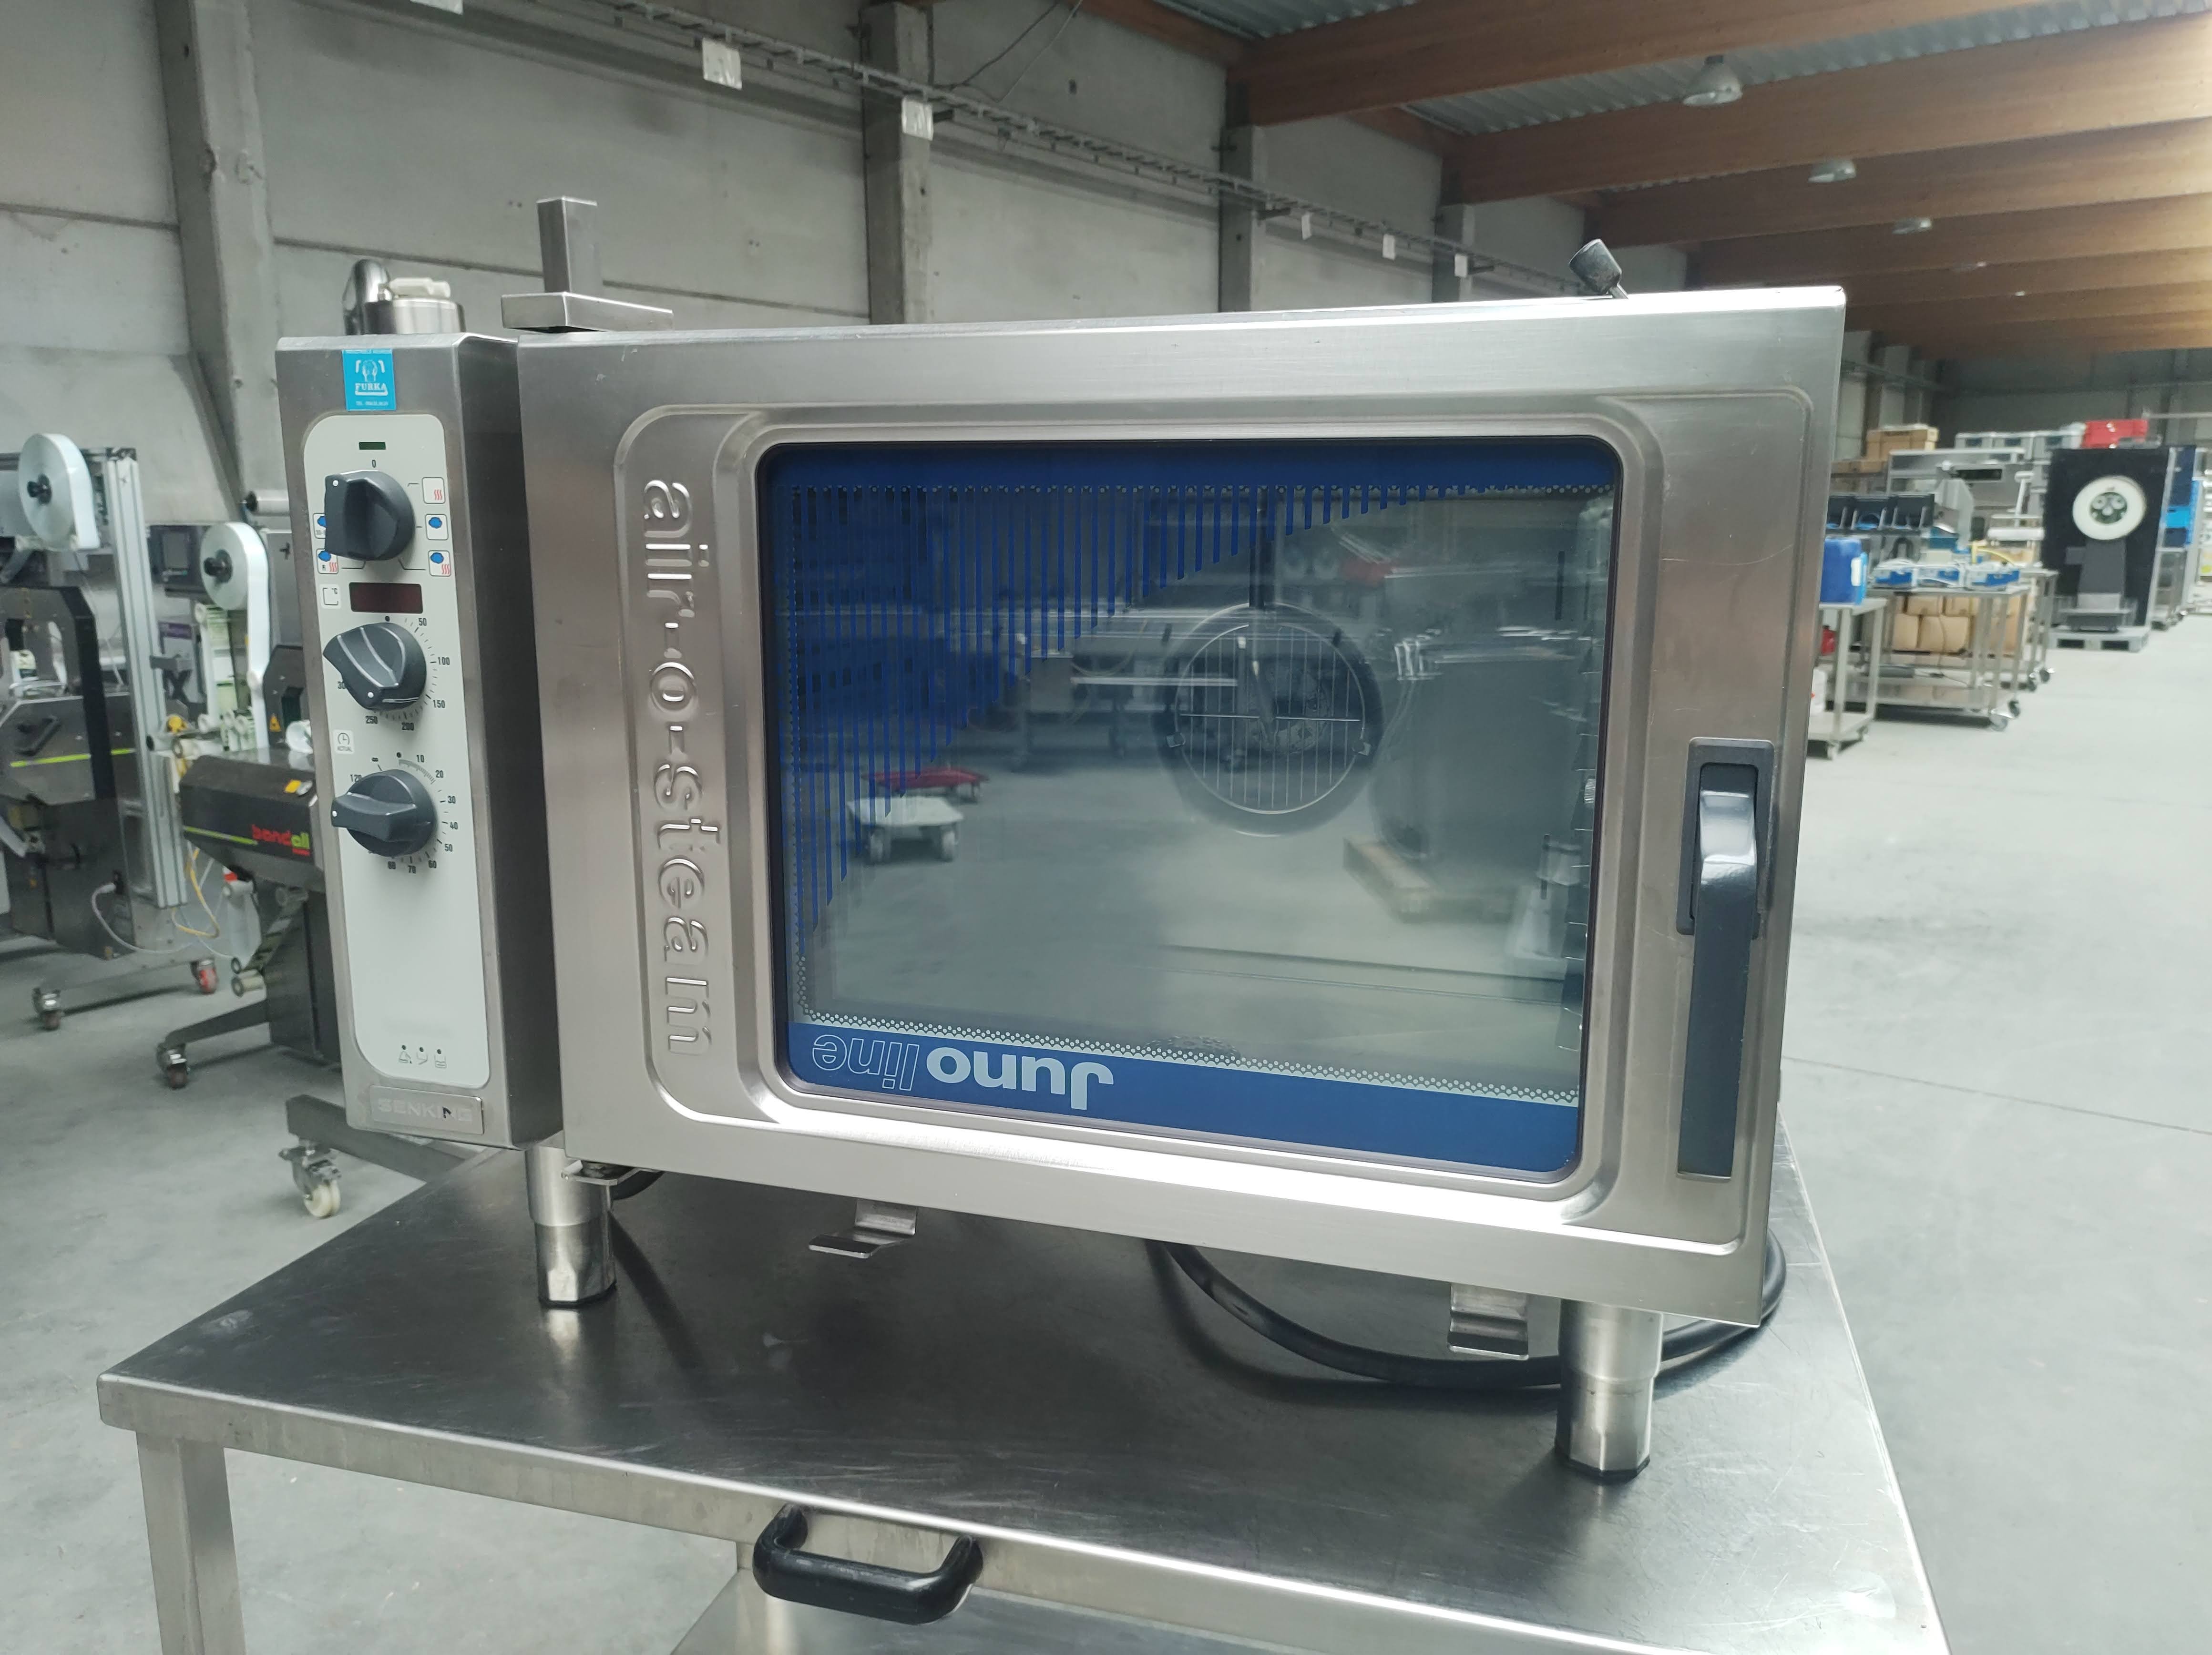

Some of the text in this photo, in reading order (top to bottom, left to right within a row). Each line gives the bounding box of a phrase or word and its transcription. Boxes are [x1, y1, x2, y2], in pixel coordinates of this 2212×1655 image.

[418, 618, 427, 626] 50
[438, 657, 450, 665] 100
[433, 700, 445, 708] 150
[365, 715, 378, 724] 250
[416, 755, 425, 763] 10
[644, 480, 718, 1055] air-o-steam
[435, 770, 444, 778] 20
[448, 796, 456, 804] 30
[450, 822, 458, 830] 40
[445, 844, 453, 852] 50
[408, 865, 416, 874] 70
[812, 1033, 1115, 1111] Juno line
[377, 1097, 473, 1122] SENKING
